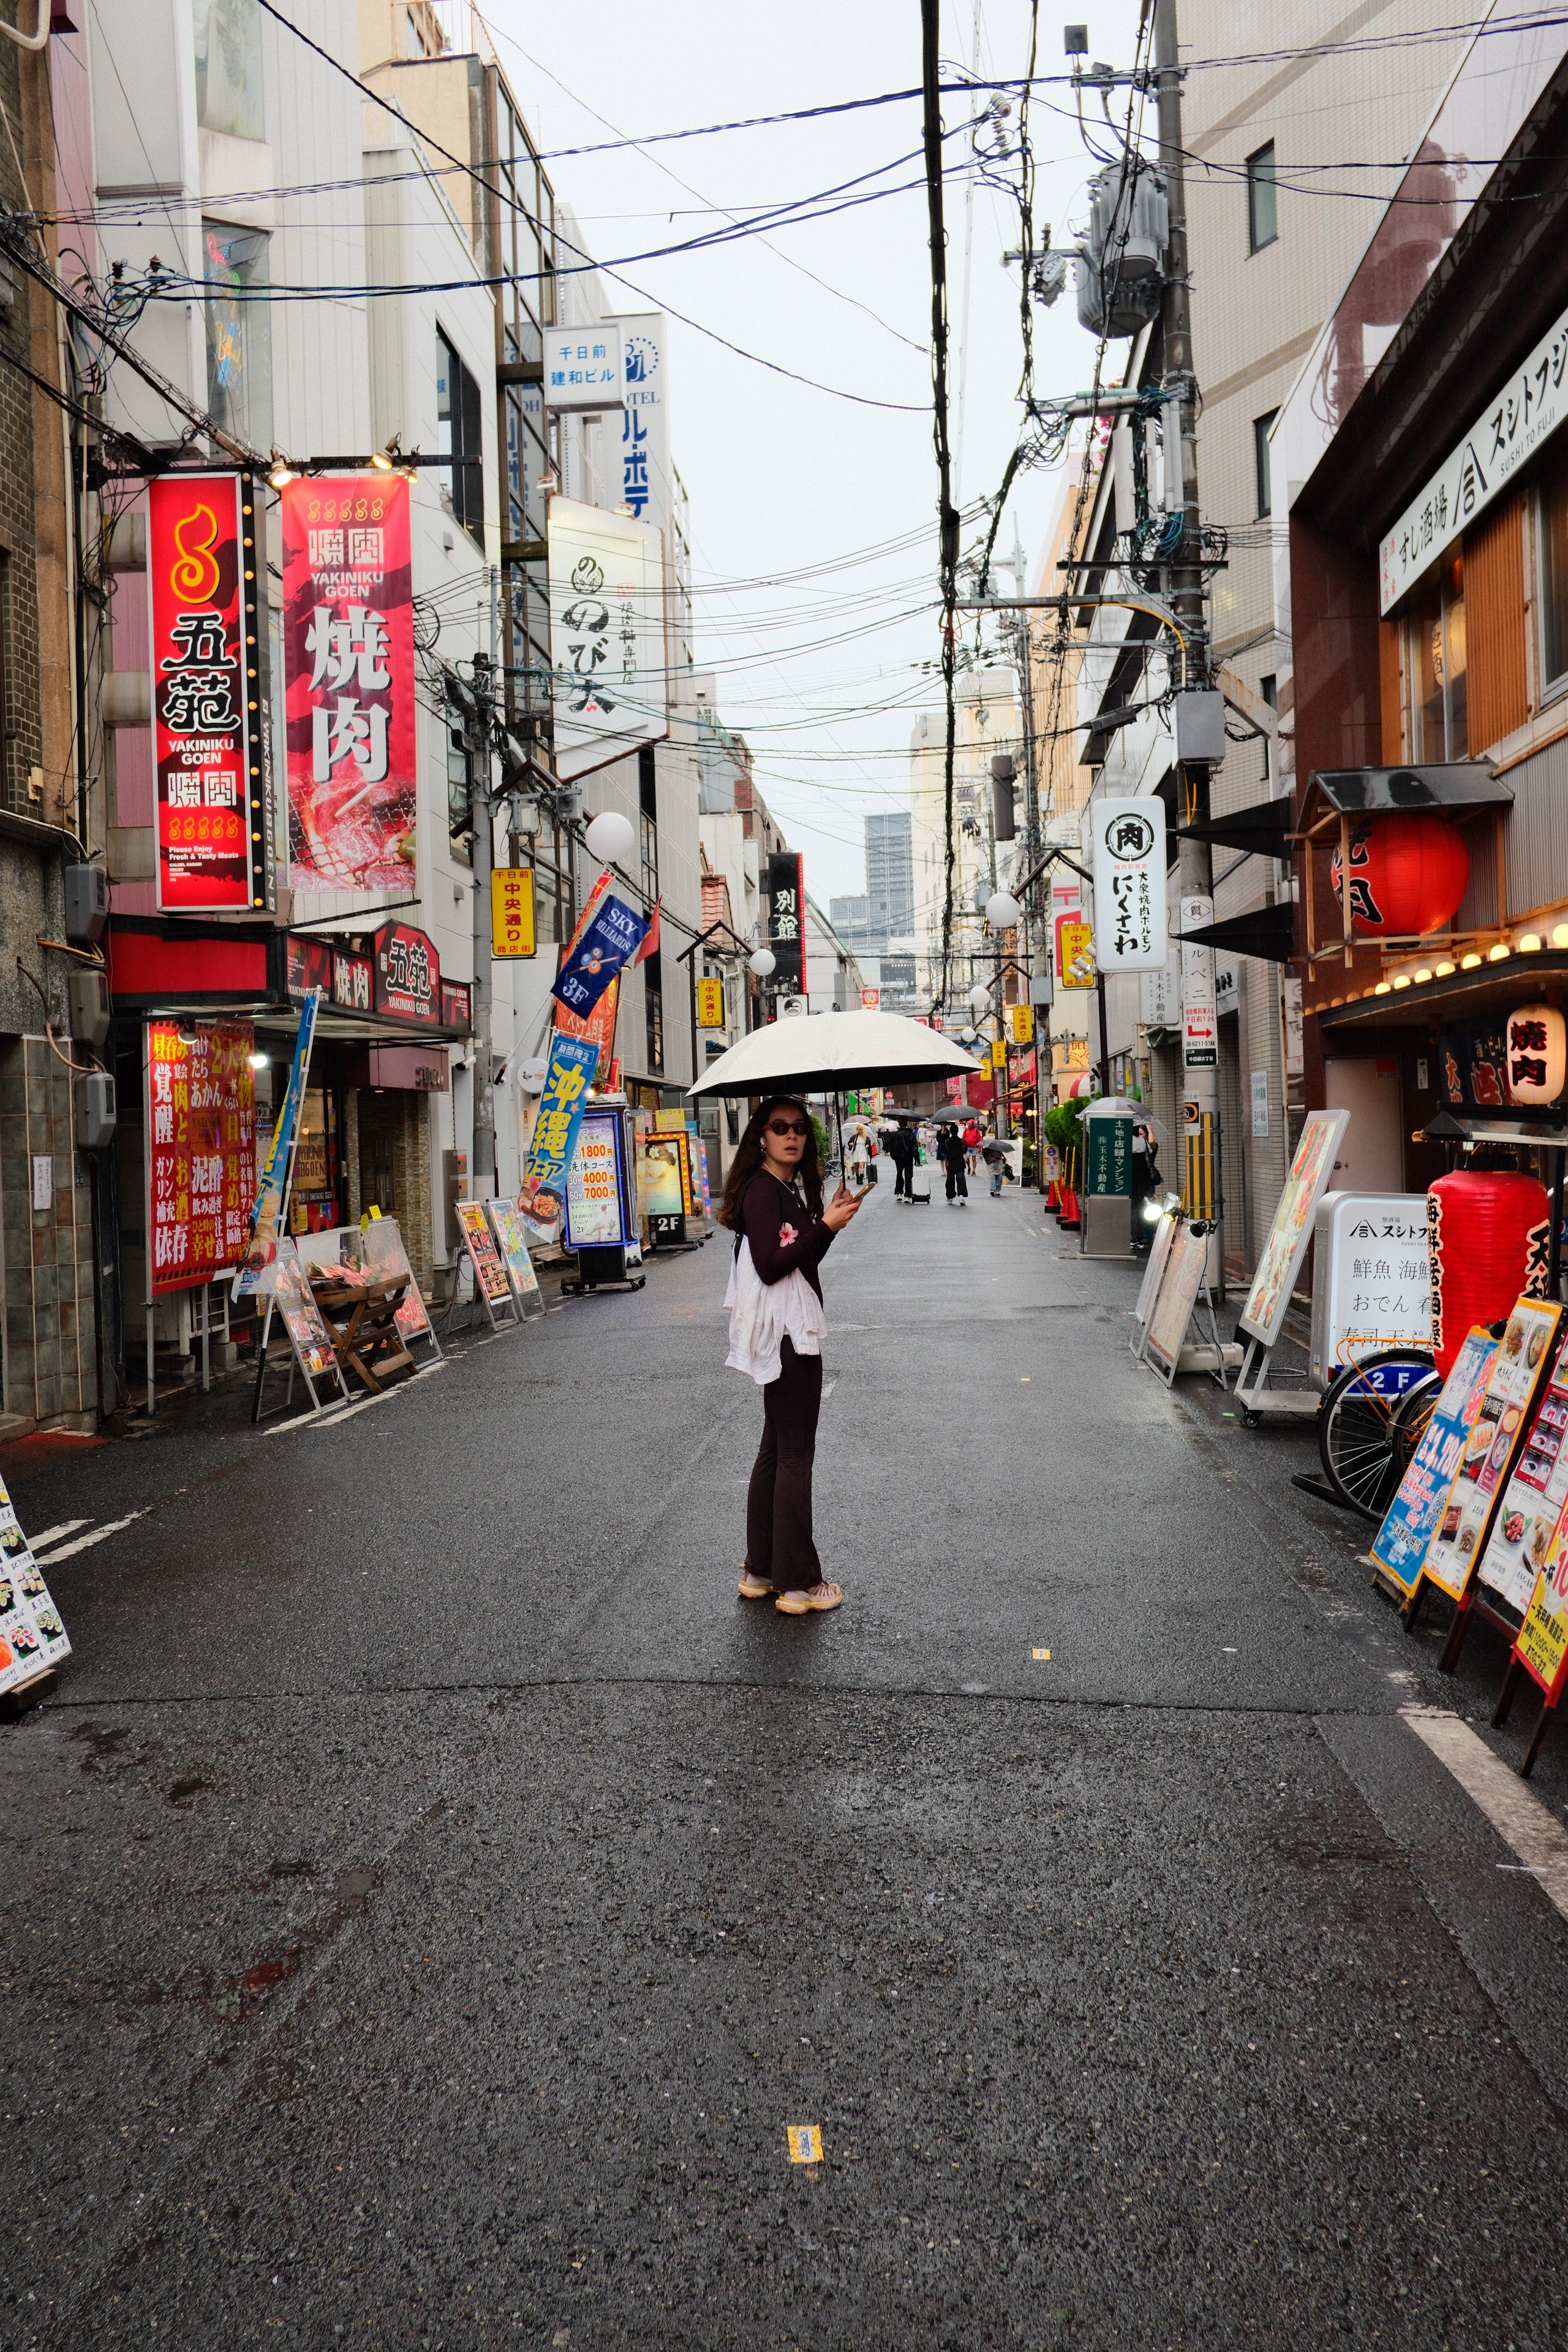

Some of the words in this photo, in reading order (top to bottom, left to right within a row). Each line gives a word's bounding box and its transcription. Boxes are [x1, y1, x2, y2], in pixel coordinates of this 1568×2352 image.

[559, 344, 606, 360] 千日前
[551, 369, 614, 386] 建和ビル
[1490, 327, 1568, 466] スシトフジ
[1500, 445, 1524, 477] SUSHI
[1526, 429, 1536, 450] TO
[1537, 405, 1555, 436] FUJI
[1398, 483, 1448, 575] すし酒場
[311, 570, 384, 586] YAKINIKU
[325, 585, 370, 598] GOEN
[160, 611, 243, 735] 五苑
[304, 605, 393, 785] 焼肉
[168, 738, 235, 753] YAKINIKU
[181, 752, 222, 765] GOEN
[1117, 822, 1144, 852] 肉
[503, 882, 522, 942] 中央通り
[606, 908, 638, 937] SKY
[1112, 874, 1139, 956] にくさわ
[1137, 872, 1152, 953] 大衆焼肉ホルモン
[497, 945, 531, 954] 商店街
[595, 919, 631, 952] BILLIARDS
[336, 956, 369, 1010] 焼肉
[562, 977, 590, 1005] 3F
[388, 995, 416, 1014] YAKINIKU
[416, 1001, 430, 1016] GOEN
[704, 986, 716, 1019] 中央通り
[557, 1042, 590, 1063] 期間限定
[1510, 1020, 1548, 1087] 焼肉
[154, 1062, 174, 1145] 覚醒
[190, 1081, 224, 1108] あかん
[530, 1061, 587, 1159] 沖縄
[569, 1159, 613, 1172] 洗体コース
[1114, 1120, 1125, 1192] 土地・店舗・マンション
[191, 1155, 224, 1194] 泥酔
[568, 1175, 582, 1186] 30分
[582, 1170, 615, 1185] 4000円
[569, 1189, 582, 1201] 60分
[583, 1185, 616, 1200] 7000円
[658, 1216, 679, 1231] 2F
[1380, 1224, 1428, 1239] スシトフ
[154, 1224, 189, 1268] 依存
[192, 1232, 215, 1262] 幸せ
[1352, 1258, 1392, 1280] 鮮魚
[1352, 1294, 1409, 1313] おでん
